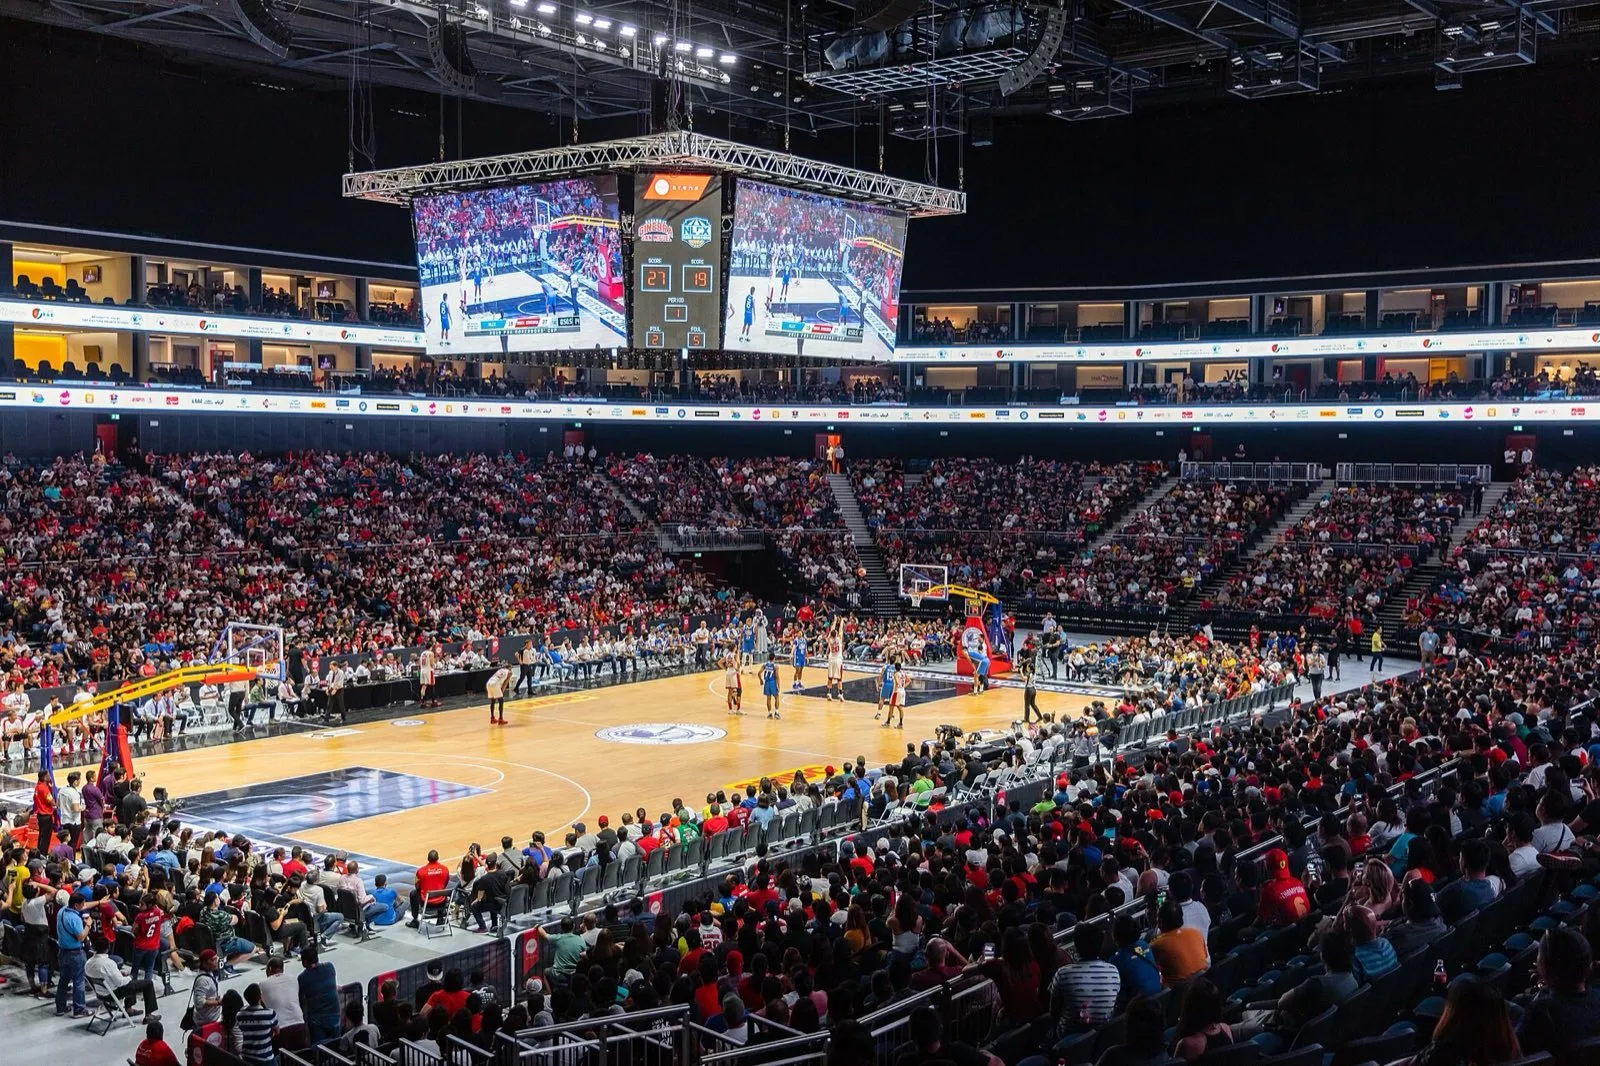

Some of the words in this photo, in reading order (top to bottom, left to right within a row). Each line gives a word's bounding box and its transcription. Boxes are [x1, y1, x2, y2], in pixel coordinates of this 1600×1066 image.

[647, 271, 666, 286] 27
[694, 272, 707, 287] 19
[676, 308, 681, 318] 1
[651, 334, 659, 345] 2
[693, 335, 701, 346] 5
[146, 923, 156, 938] 6
